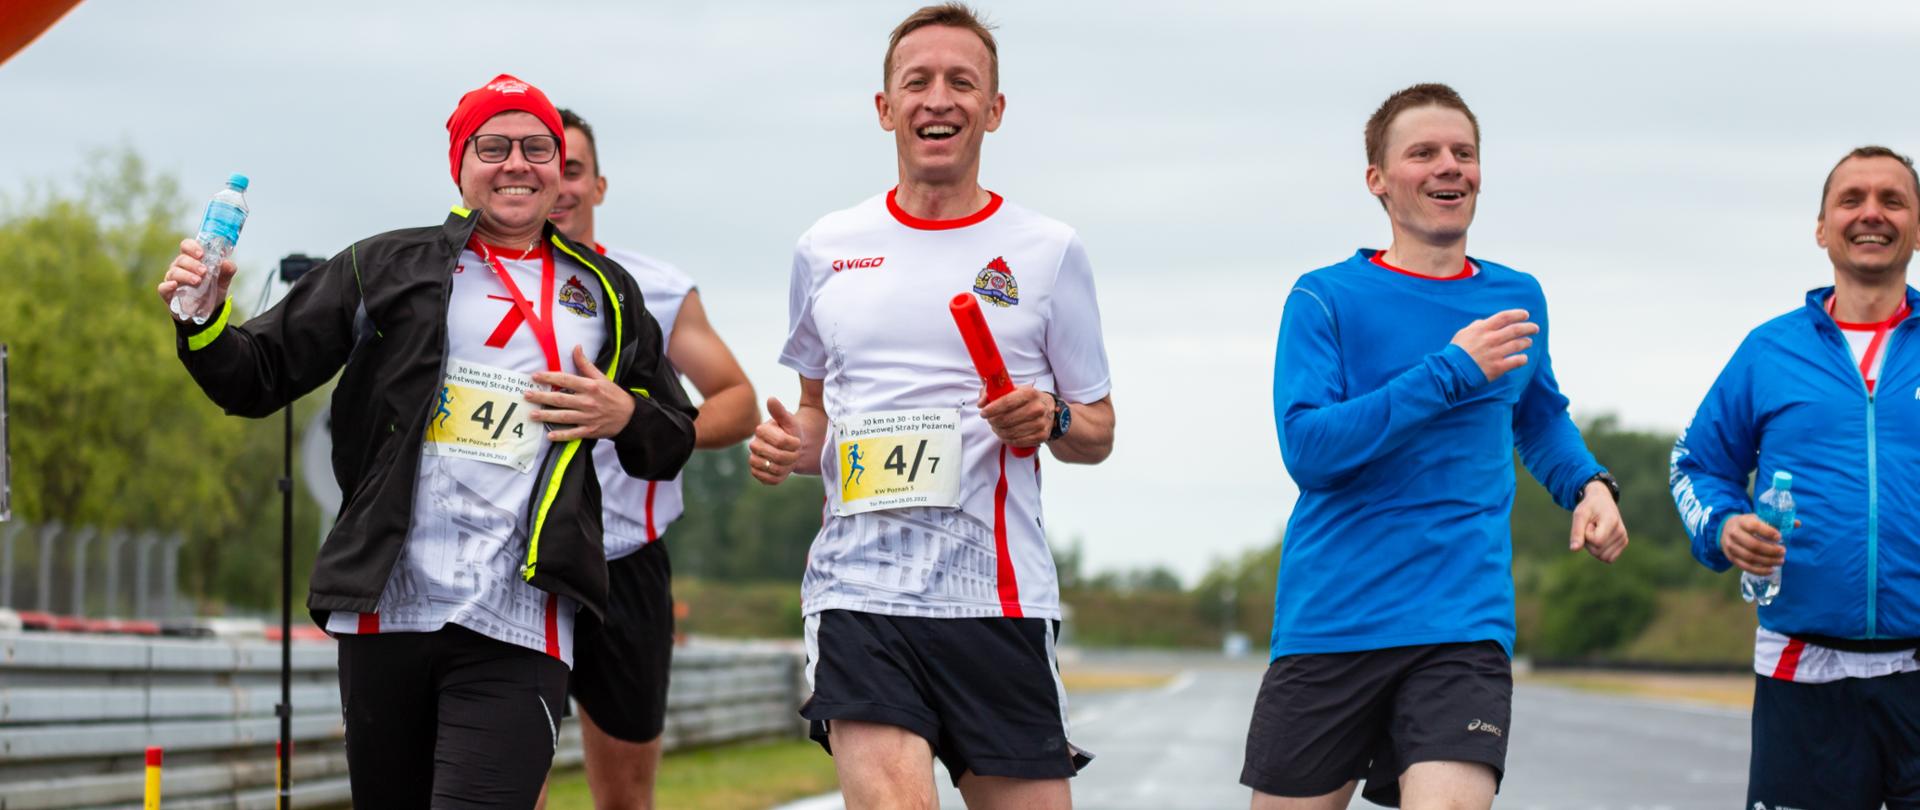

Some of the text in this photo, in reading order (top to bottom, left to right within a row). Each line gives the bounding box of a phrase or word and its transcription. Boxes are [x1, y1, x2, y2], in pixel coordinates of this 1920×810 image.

[847, 257, 885, 270] VIGO
[458, 366, 468, 374] 30
[469, 368, 480, 377] km
[482, 370, 491, 378] na
[493, 371, 502, 381] 30
[508, 376, 517, 384] to
[517, 376, 534, 389] lecie
[489, 381, 513, 393] Straży
[863, 418, 872, 426] 30
[851, 422, 956, 436] Państwowej Straży Pożarnej
[1480, 722, 1502, 737] asics
